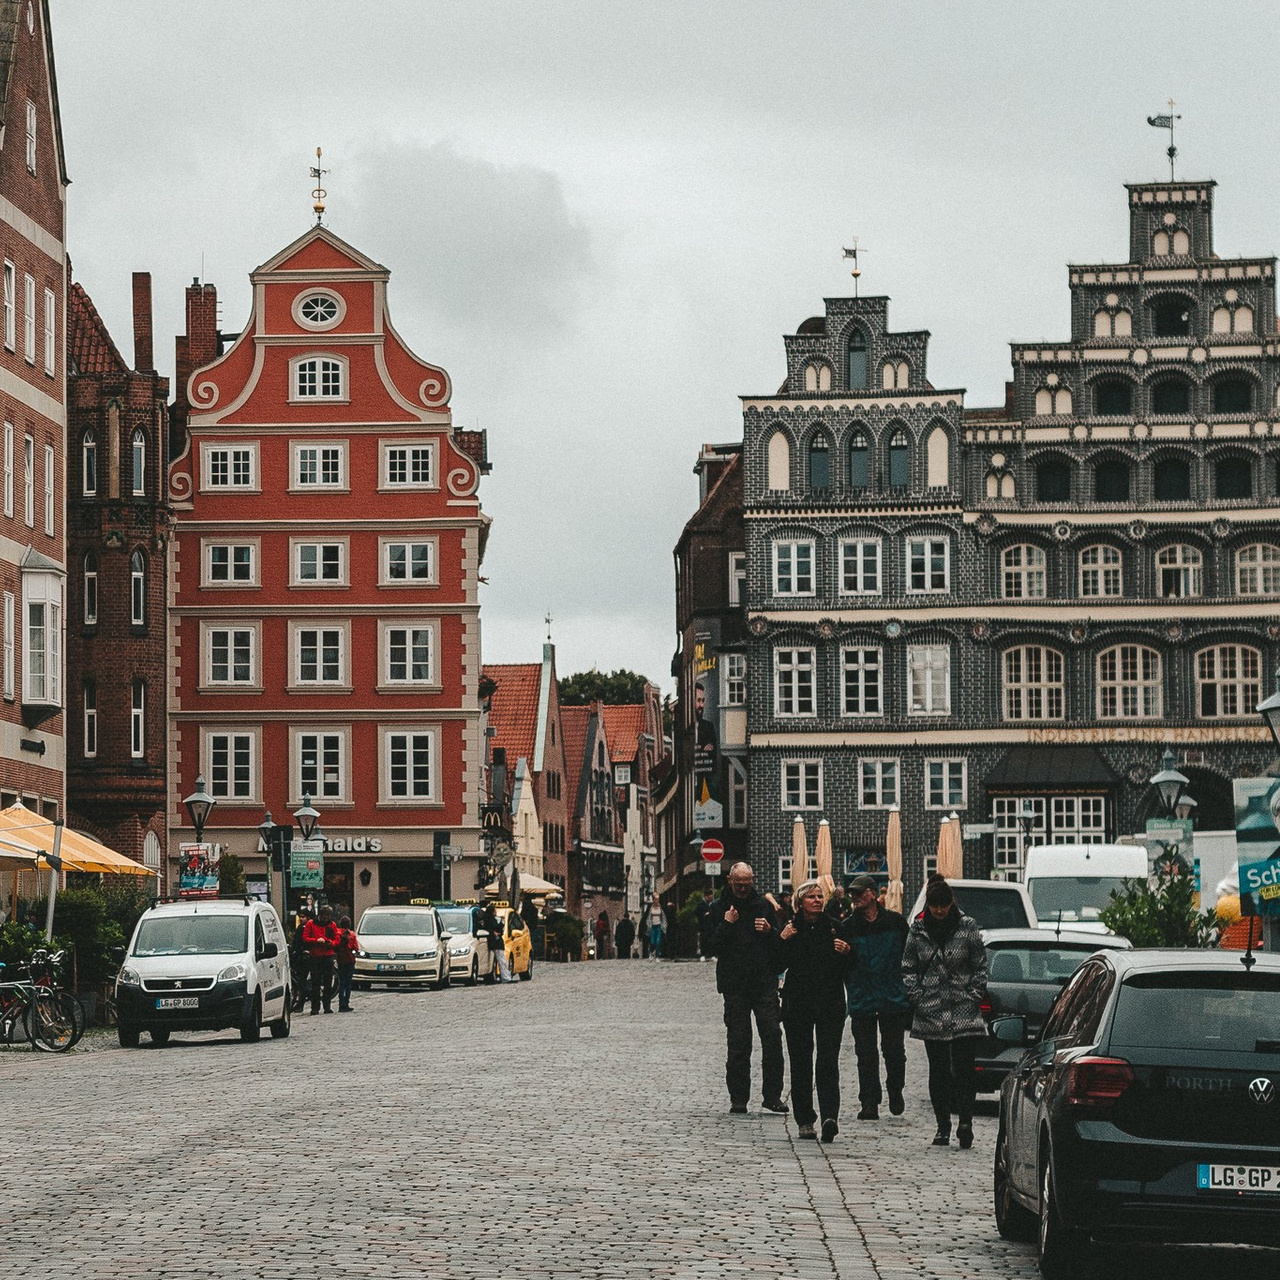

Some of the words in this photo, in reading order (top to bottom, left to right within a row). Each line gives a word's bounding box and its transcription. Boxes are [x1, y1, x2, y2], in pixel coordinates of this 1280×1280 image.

[1166, 1077, 1232, 1091] PORTH
[1211, 1167, 1234, 1186] LG
[1248, 1168, 1271, 1188] GP
